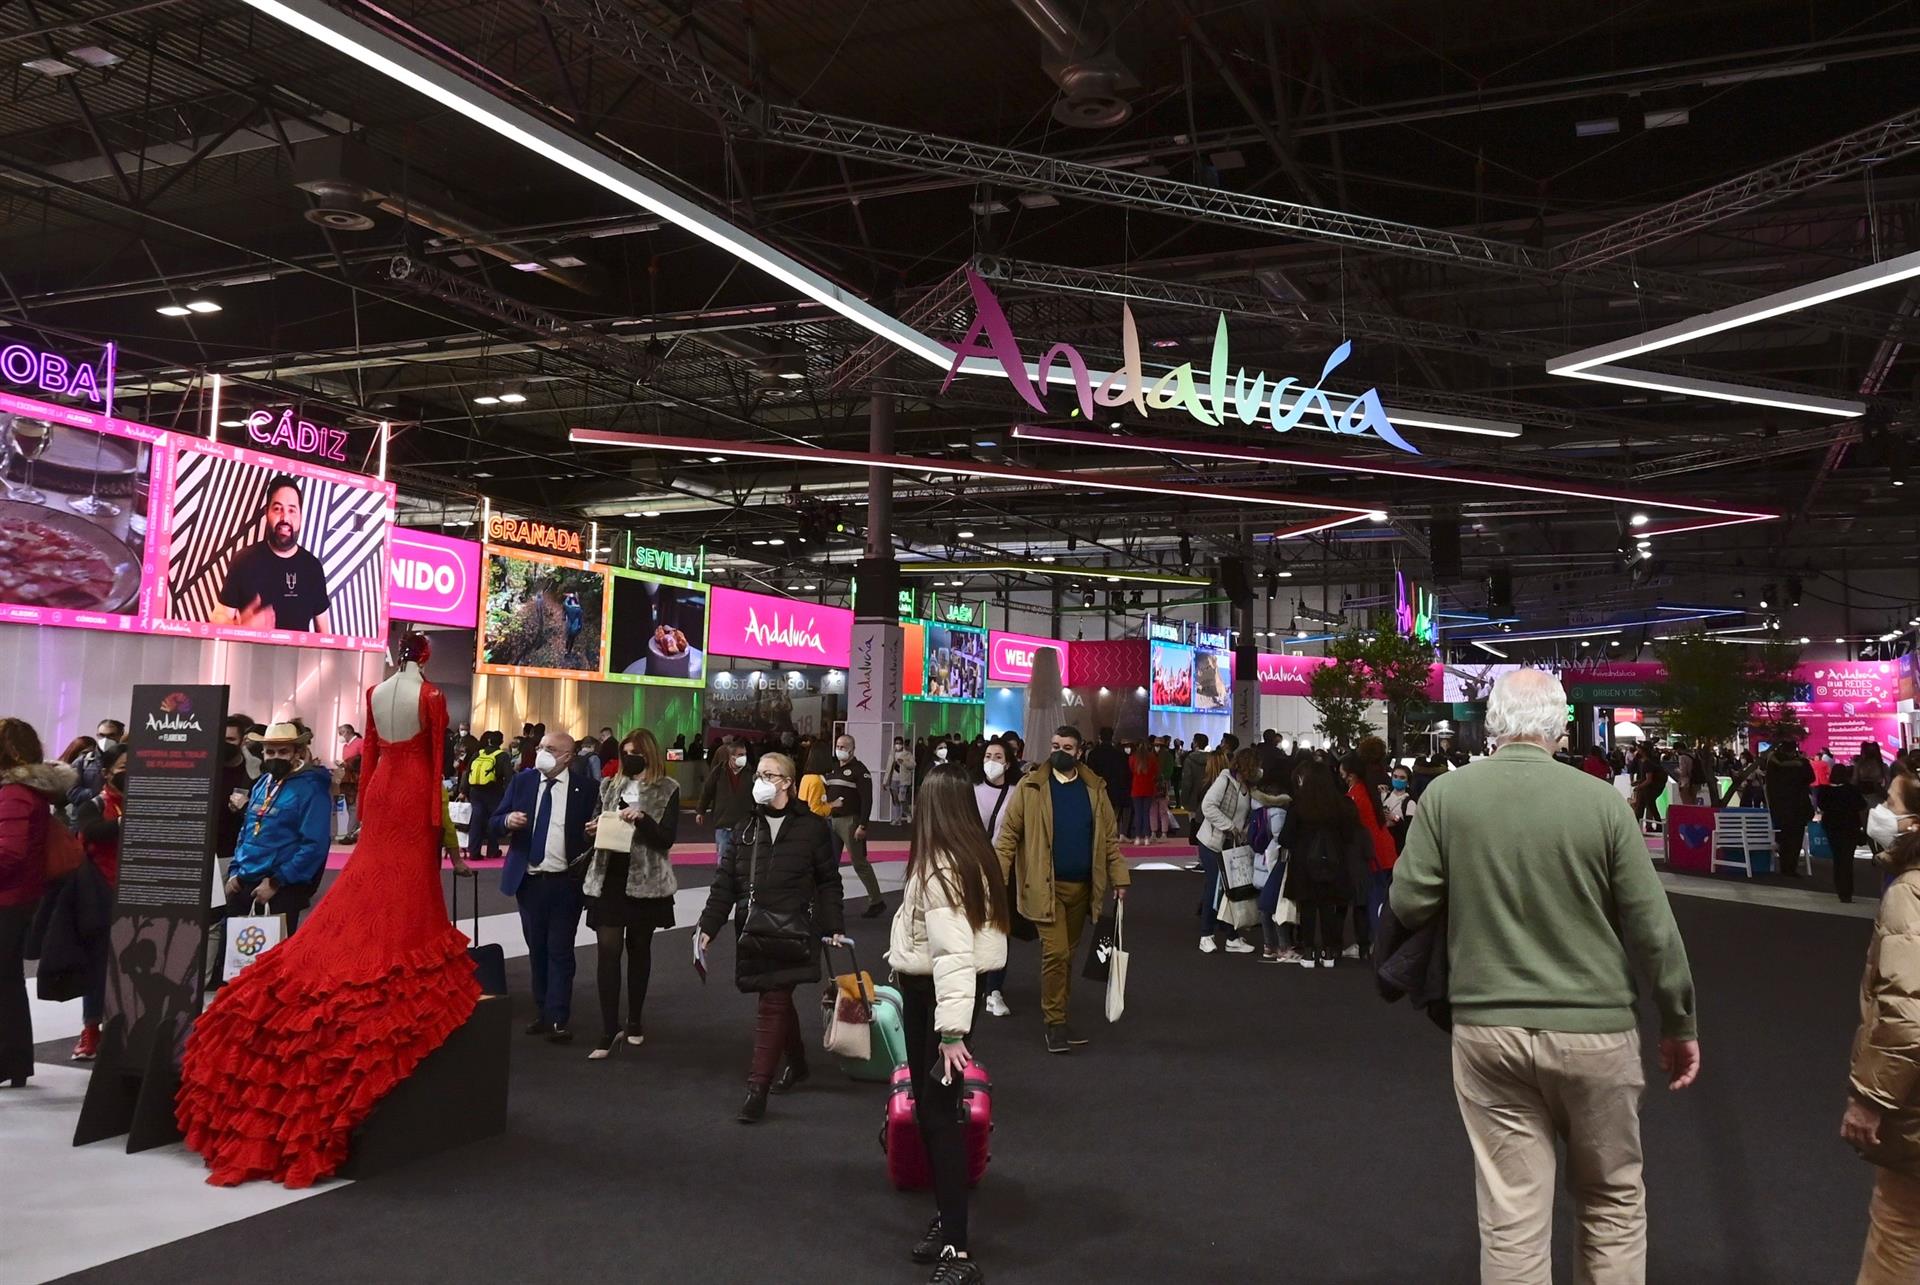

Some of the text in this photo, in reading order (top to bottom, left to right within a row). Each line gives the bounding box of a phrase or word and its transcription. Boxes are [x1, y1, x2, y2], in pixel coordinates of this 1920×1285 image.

[1, 345, 100, 402] OBA
[939, 266, 1423, 456] Andalucía
[248, 407, 346, 462] CÁDIZ
[488, 515, 582, 555] GRANADA
[391, 558, 455, 594] NIDO
[636, 546, 696, 577] SEVILLA
[946, 603, 973, 623] JAÉN
[744, 607, 825, 654] Andalucía
[855, 635, 875, 712] Andalucía
[1005, 648, 1035, 668] WELC
[714, 679, 754, 690] COSTA
[759, 678, 783, 691] DEL
[787, 679, 813, 691] SOL
[1827, 668, 1882, 681] Andalucía
[1845, 679, 1873, 688] REDES
[1833, 689, 1873, 698] SOCIALES
[145, 712, 203, 732] Andalucía
